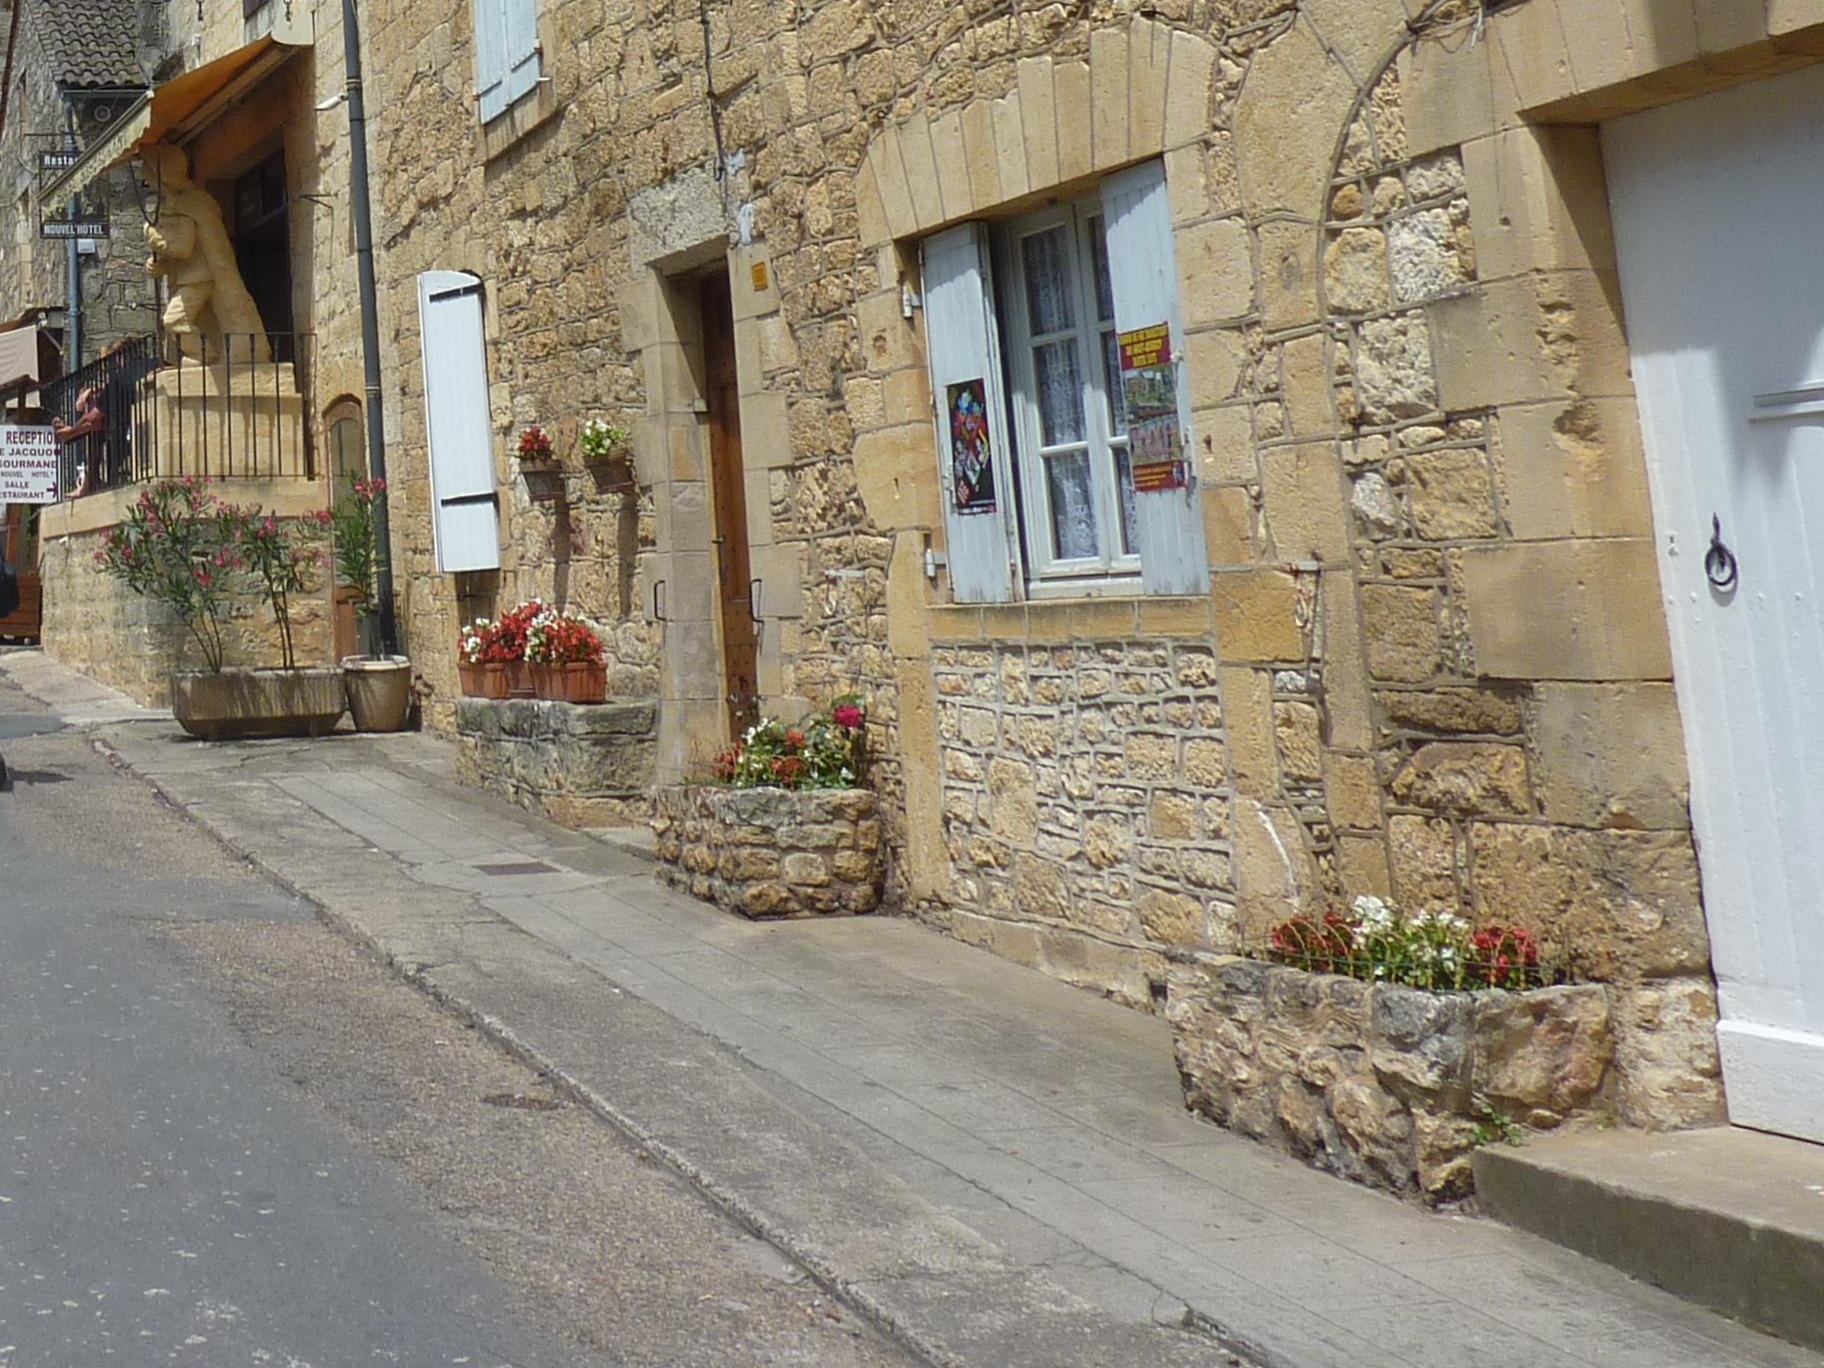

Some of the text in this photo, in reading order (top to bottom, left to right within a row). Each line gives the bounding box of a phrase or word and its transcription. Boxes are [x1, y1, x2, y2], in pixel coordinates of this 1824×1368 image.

[44, 224, 104, 235] NOUVEL HOTEL
[6, 430, 60, 445] RECEPTIO
[5, 481, 29, 489] SALLE
